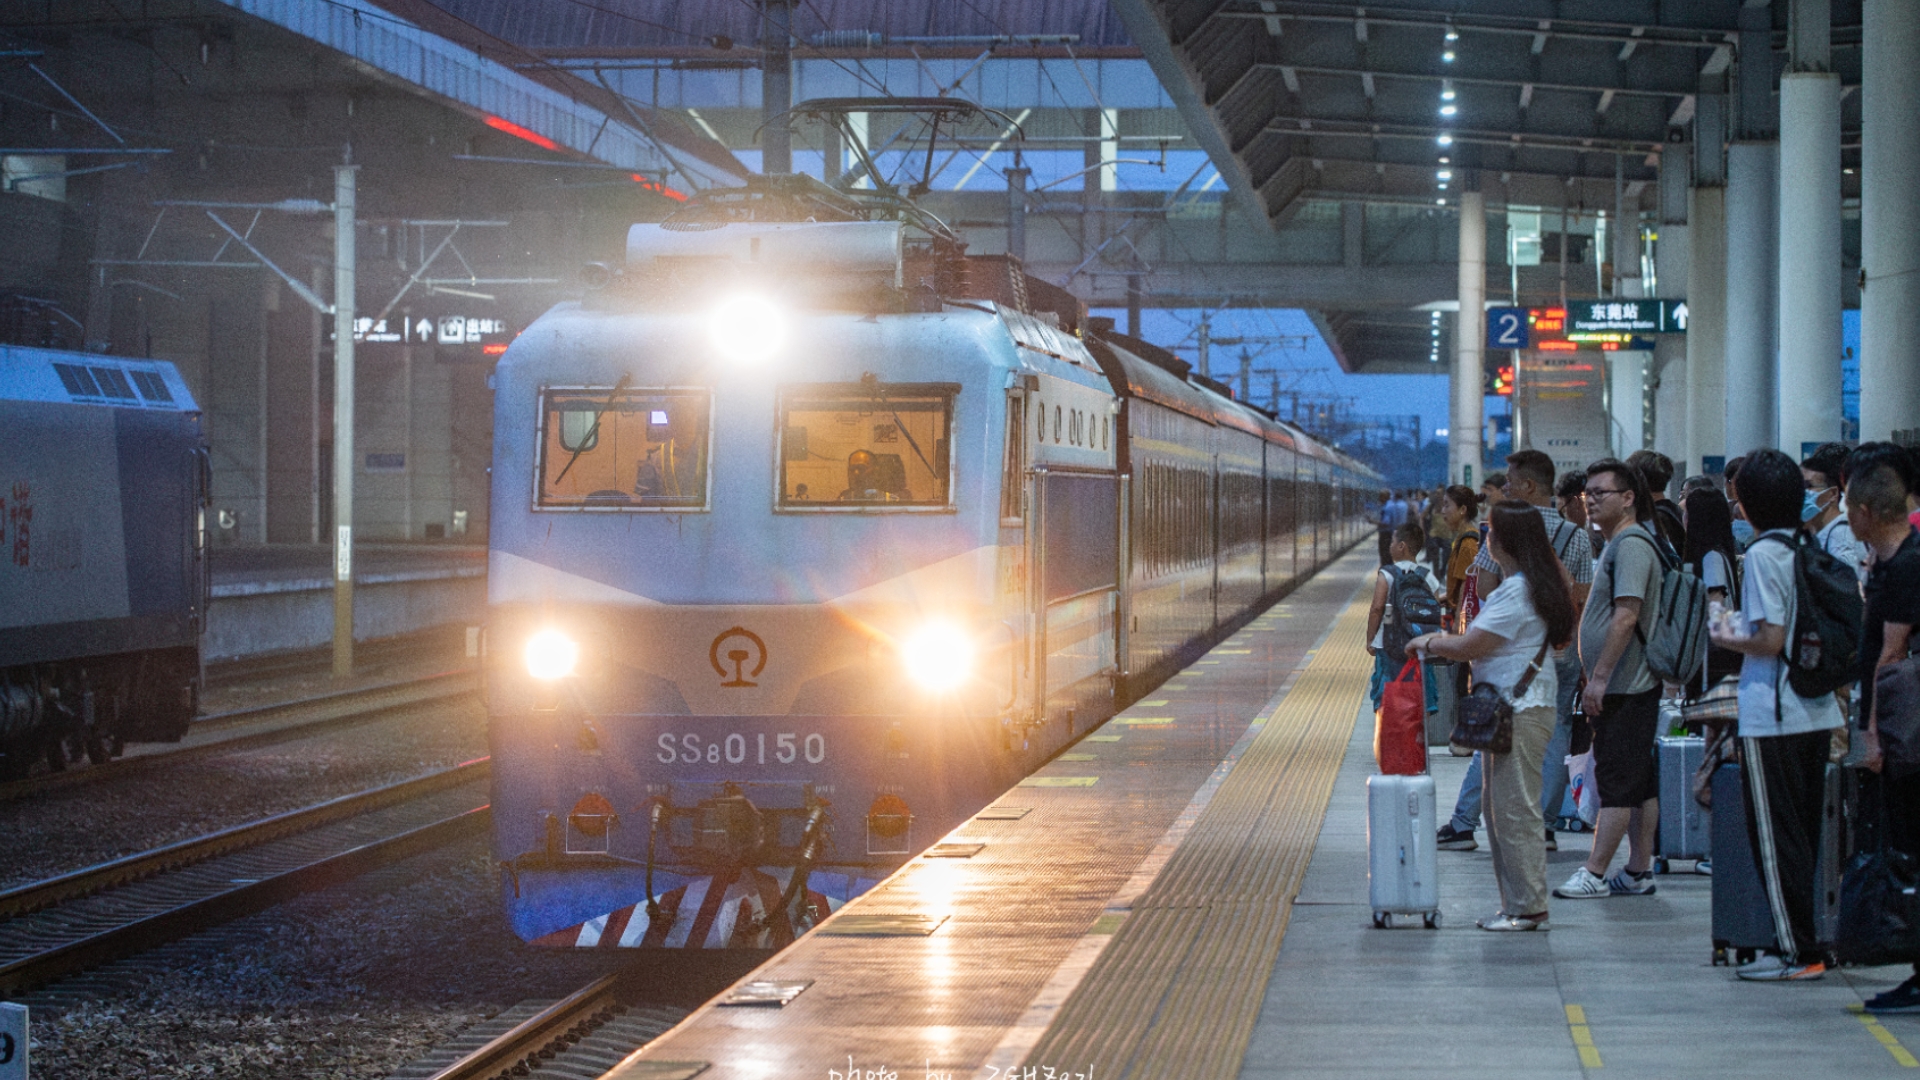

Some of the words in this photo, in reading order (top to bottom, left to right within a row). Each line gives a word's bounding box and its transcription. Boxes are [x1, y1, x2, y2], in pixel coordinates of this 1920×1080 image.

[1591, 303, 1638, 321] 东莞站
[466, 318, 506, 333] 出站口
[1499, 314, 1519, 344] 2
[1632, 320, 1655, 329] Station
